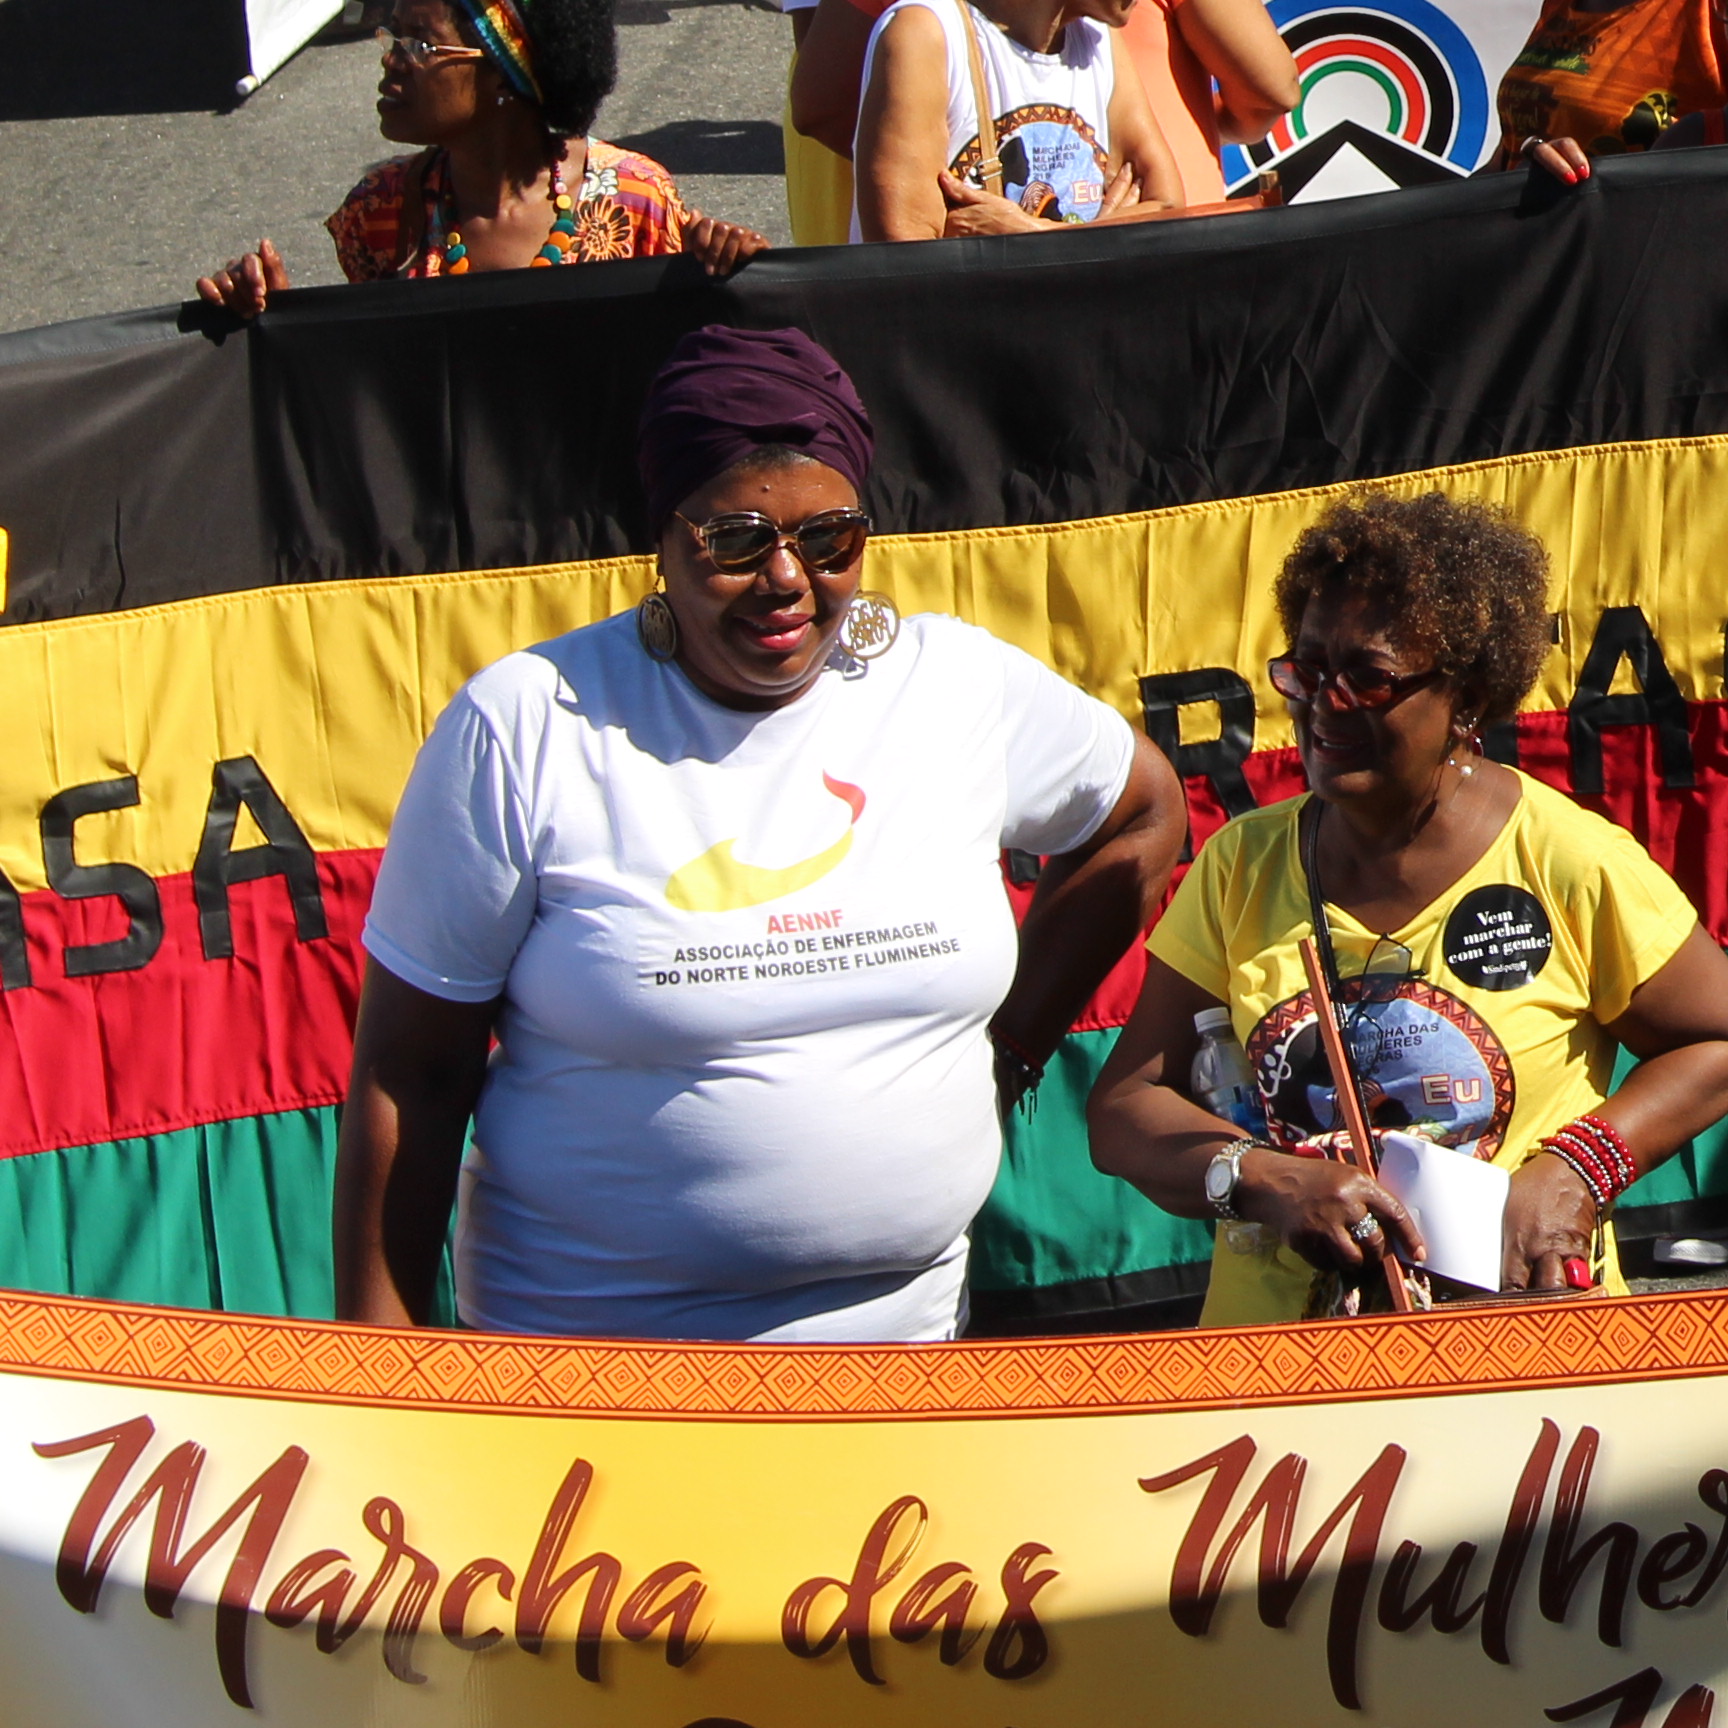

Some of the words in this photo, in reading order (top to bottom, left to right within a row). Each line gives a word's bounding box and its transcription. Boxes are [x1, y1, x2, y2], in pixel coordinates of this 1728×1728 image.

[1072, 180, 1102, 205] Eu
[766, 909, 844, 935] AENNF
[1477, 910, 1514, 927] Vem
[674, 939, 789, 963] ASSOCIAÇÃO
[795, 938, 818, 954] DE
[822, 921, 939, 952] ENFERMAGEM
[1448, 948, 1484, 965] com
[1489, 942, 1499, 955] a
[1502, 932, 1552, 956] gente!
[1463, 922, 1534, 946] marchar
[655, 970, 681, 986] DO
[687, 966, 749, 984] NORTE
[755, 956, 850, 979] NOROESTE
[855, 937, 961, 969] FLUMINENSE
[1409, 1022, 1440, 1035] DAS
[1421, 1074, 1485, 1107] Eu
[30, 1413, 718, 1710] Marcha
[781, 1493, 1063, 1687] das
